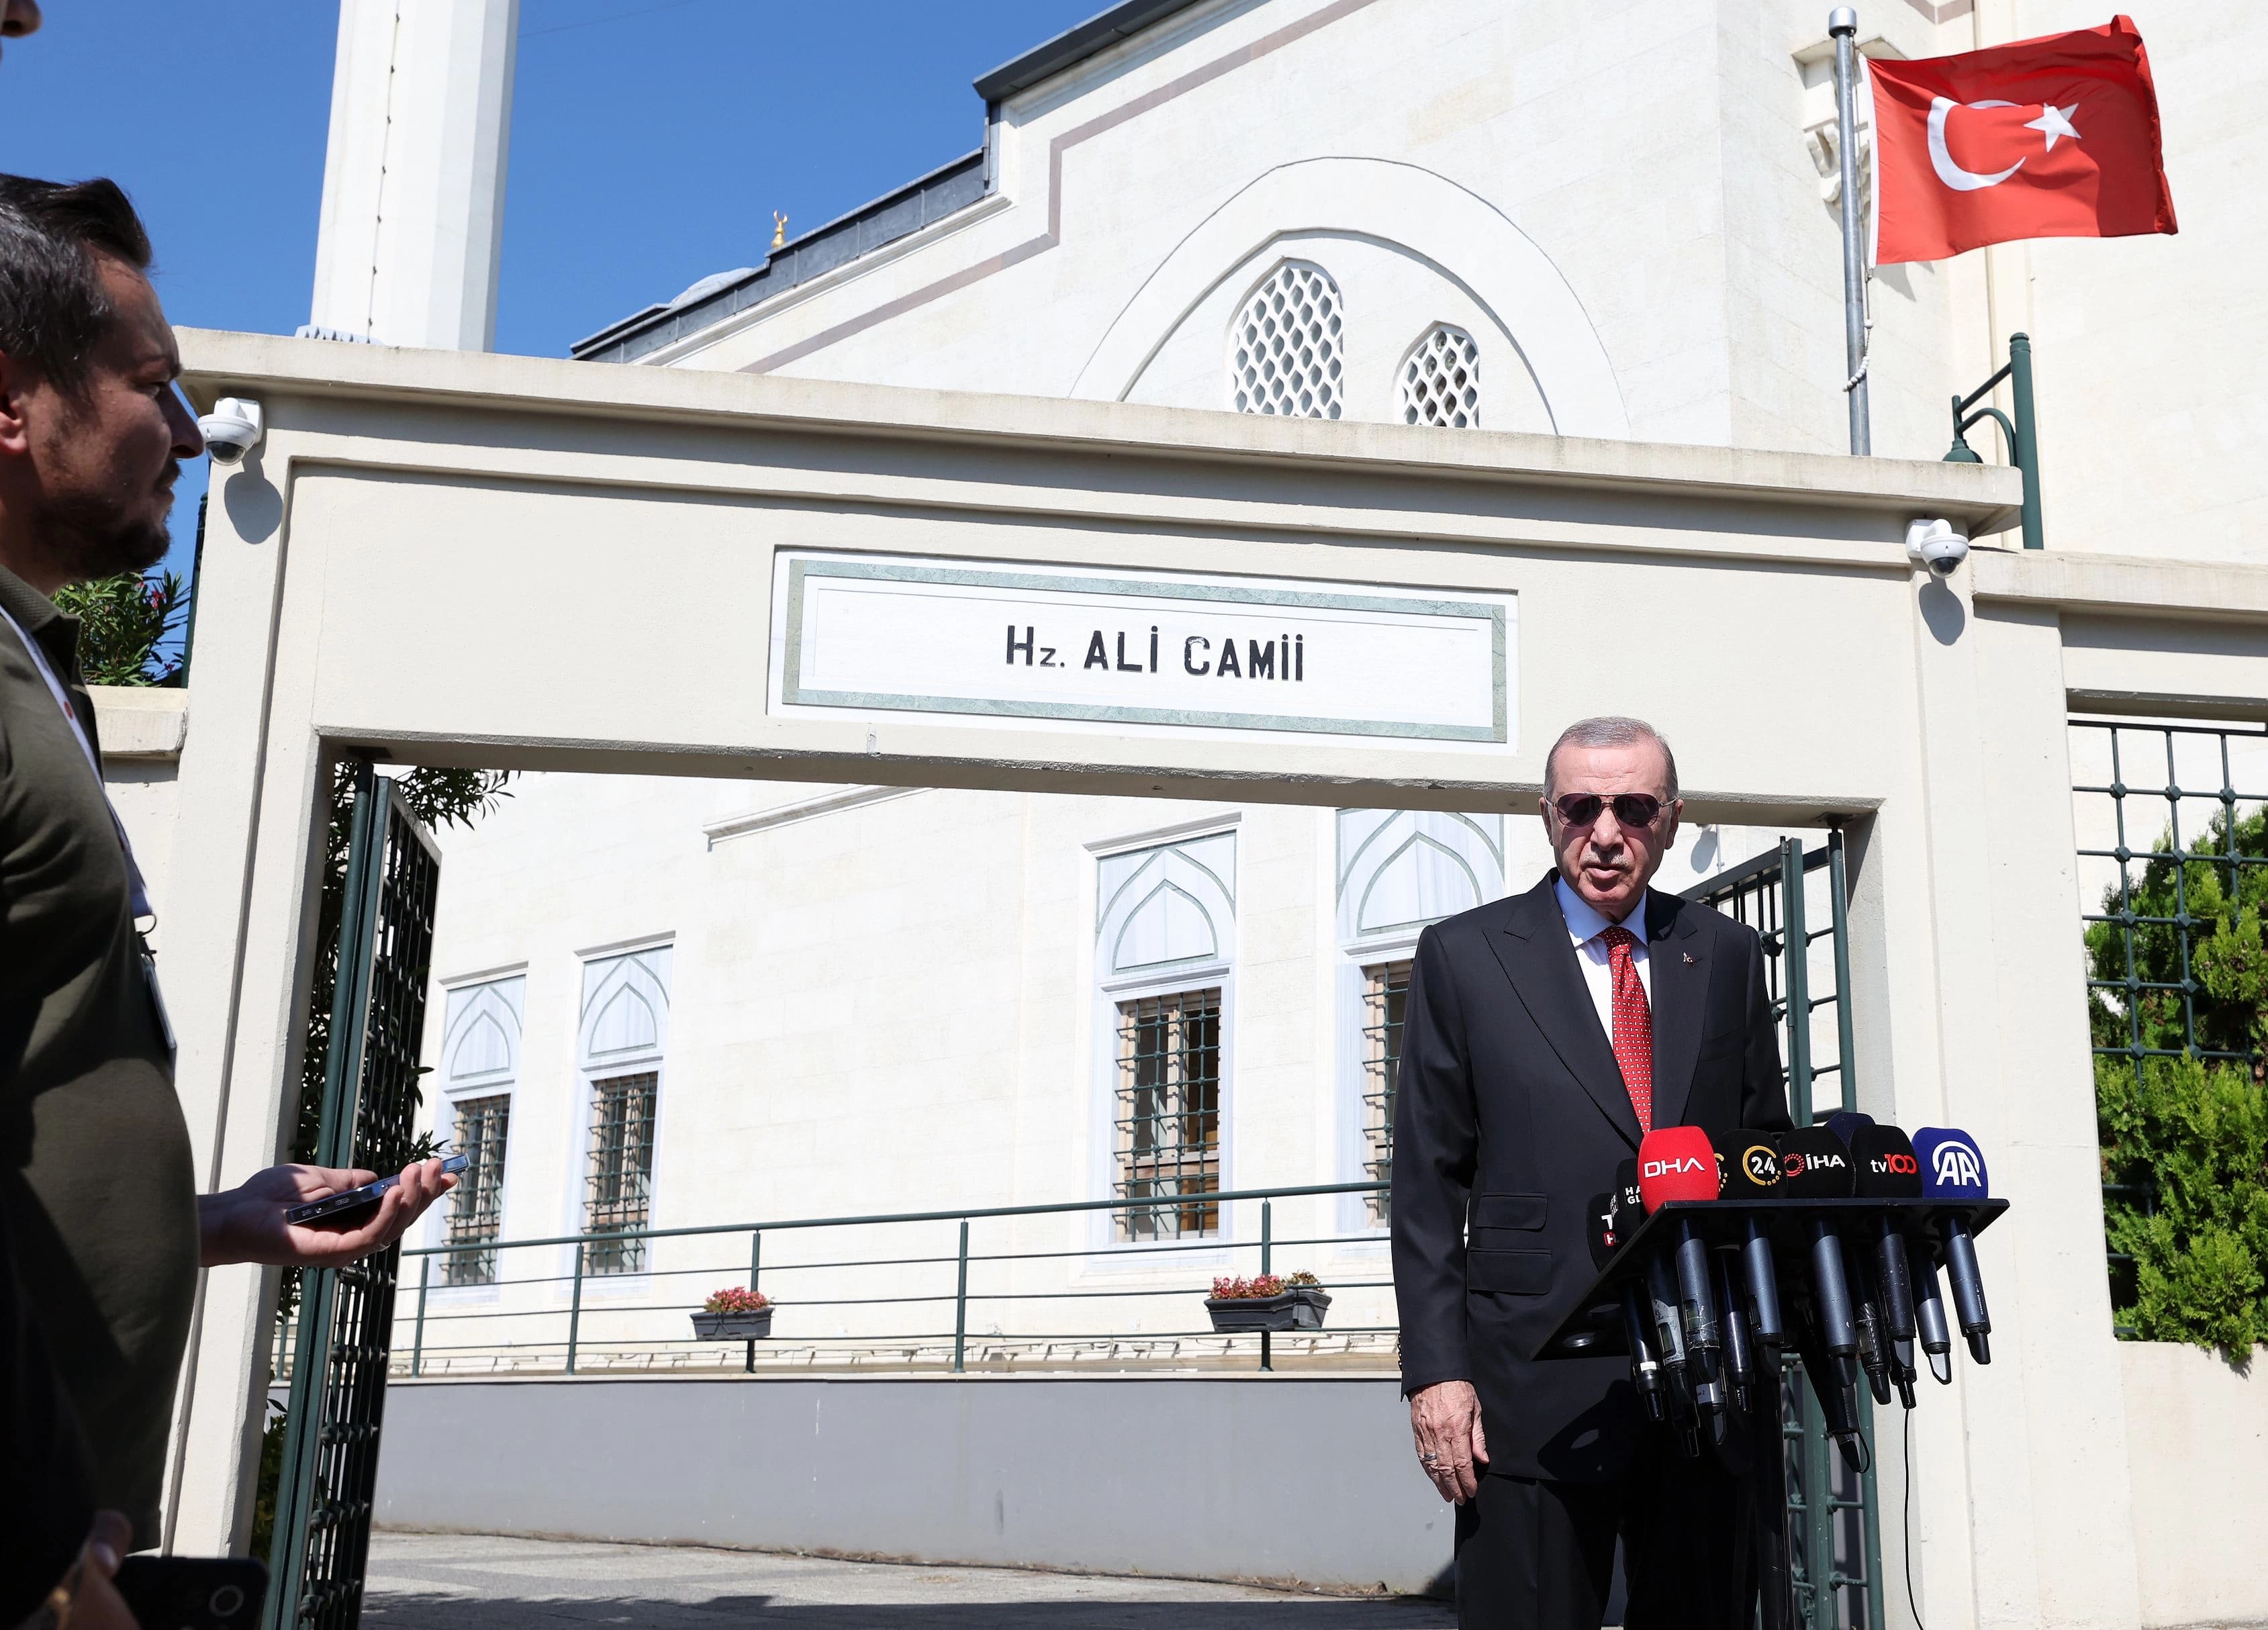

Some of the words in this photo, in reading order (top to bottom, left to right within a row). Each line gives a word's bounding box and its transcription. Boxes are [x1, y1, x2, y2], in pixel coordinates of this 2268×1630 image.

[1644, 1157, 1705, 1178] DHA
[1751, 1156, 1776, 1174] 24
[1936, 1151, 1982, 1187] AA
